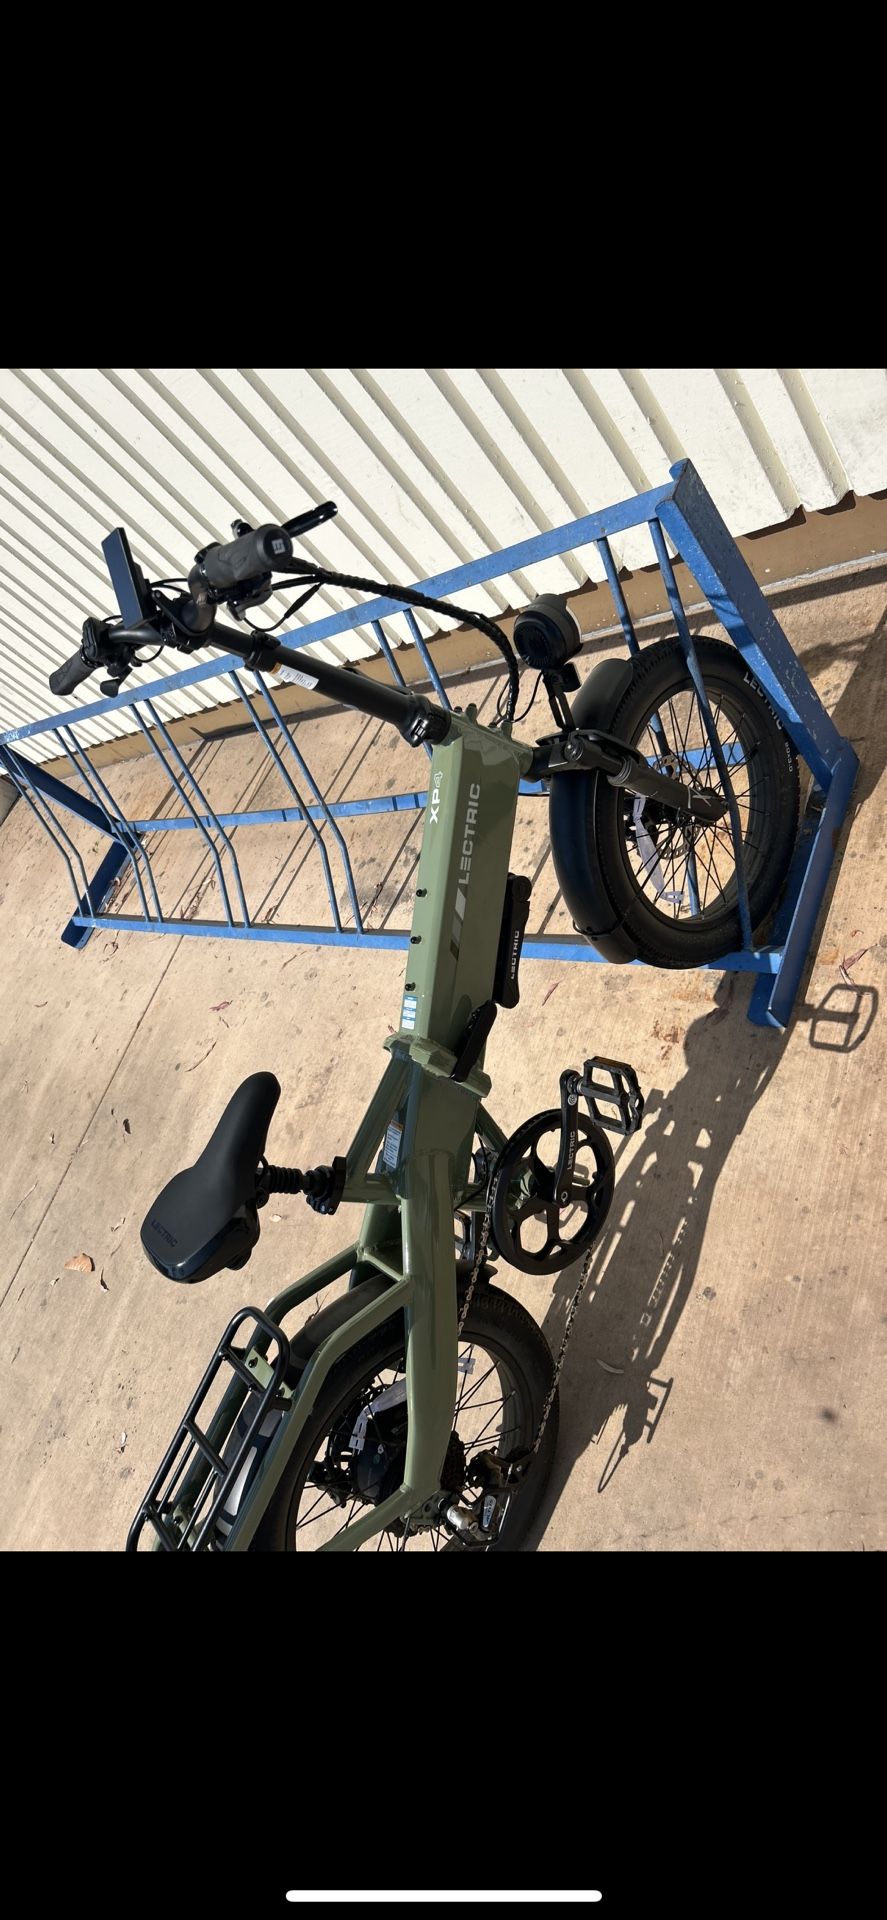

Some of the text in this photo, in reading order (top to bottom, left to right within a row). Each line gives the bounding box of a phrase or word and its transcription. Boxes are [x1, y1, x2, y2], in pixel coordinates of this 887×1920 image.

[429, 770, 443, 824] XP4
[458, 783, 481, 885] LECTRIC
[510, 930, 520, 980] LECTRIC
[567, 1130, 576, 1170] LECTRIC
